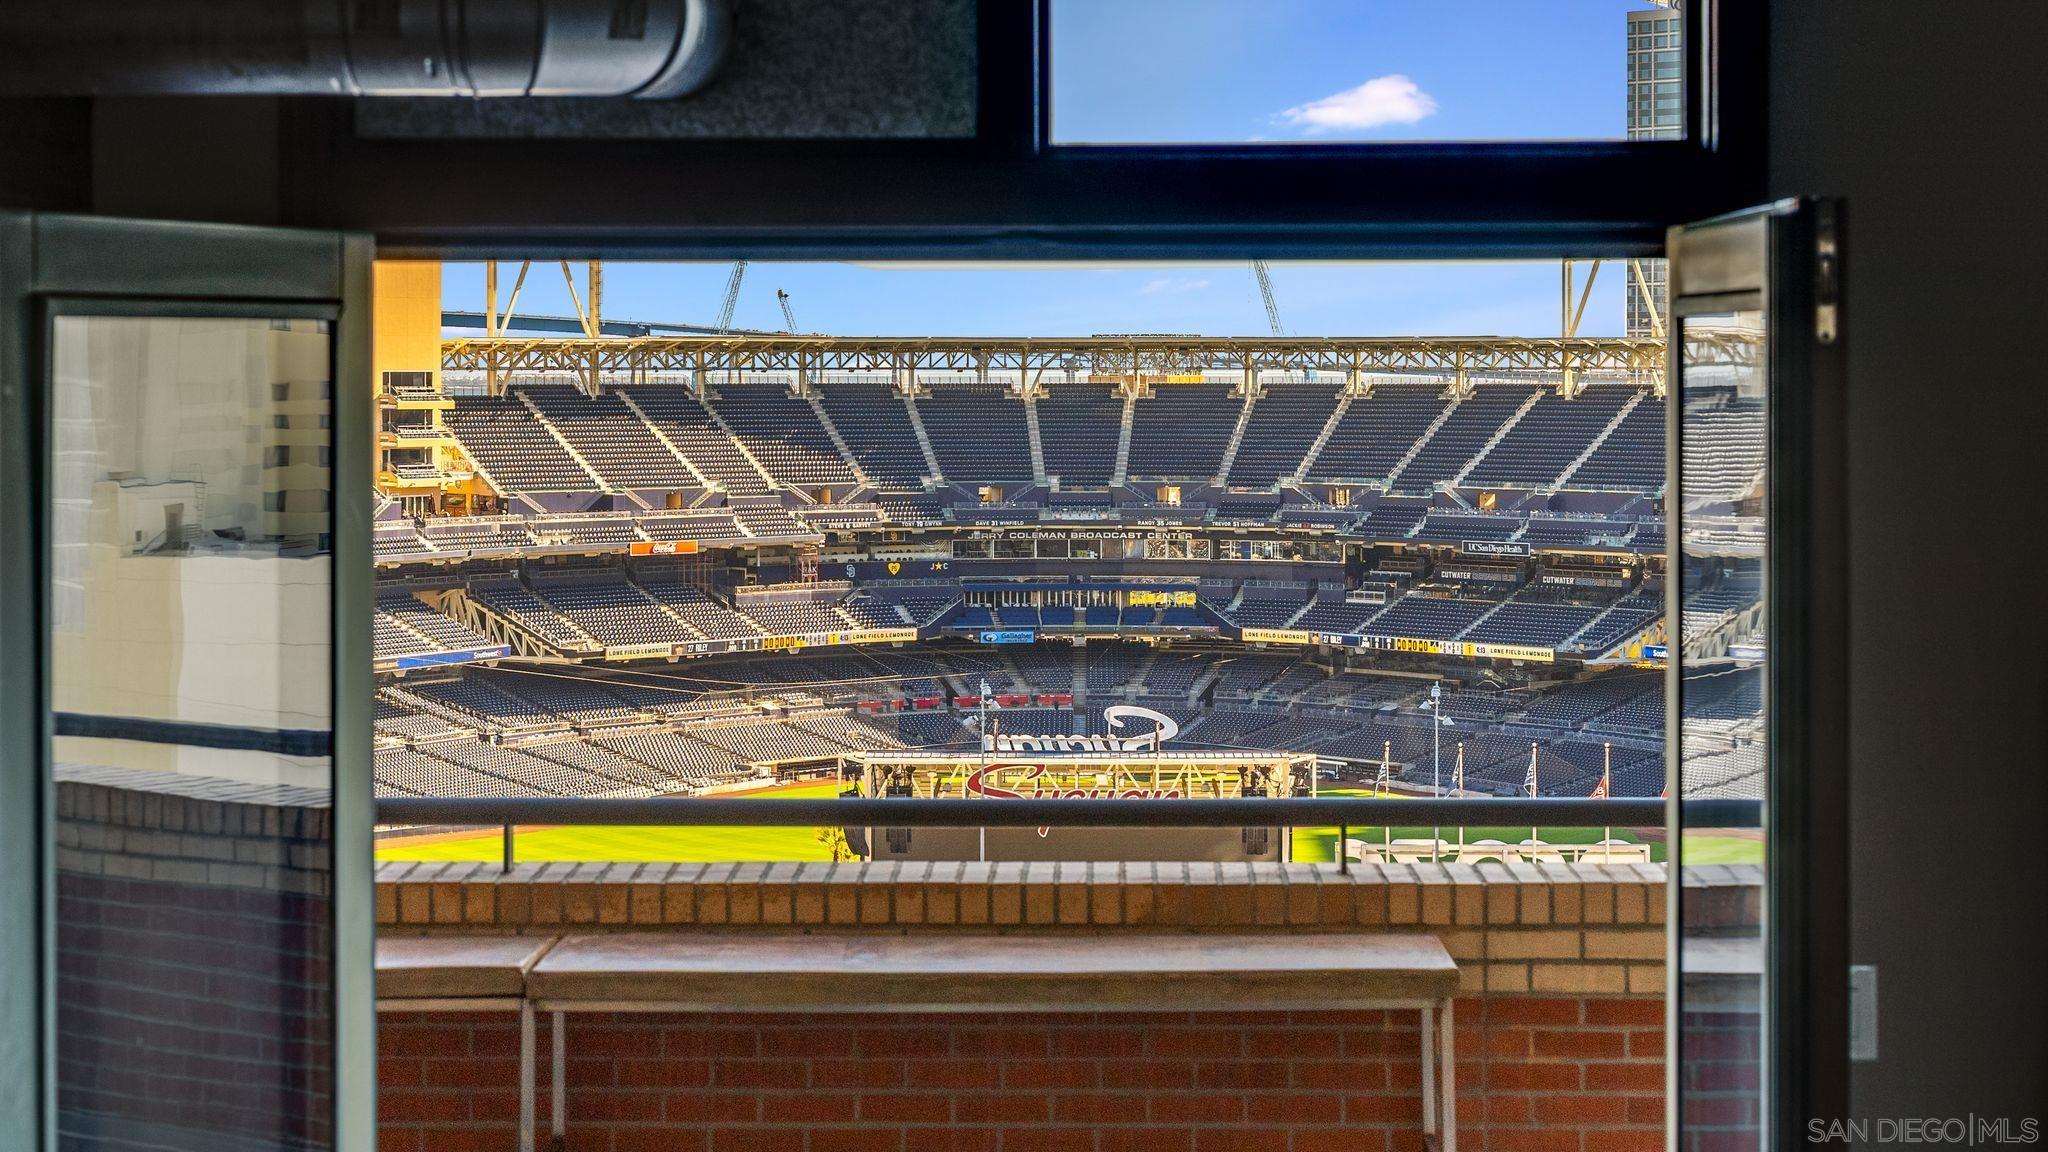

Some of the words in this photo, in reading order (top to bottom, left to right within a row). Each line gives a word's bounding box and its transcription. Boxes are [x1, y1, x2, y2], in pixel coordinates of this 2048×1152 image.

[968, 532, 1004, 540] JERRY
[1147, 532, 1193, 540] CENTER
[1468, 543, 1478, 552] UC
[1478, 544, 1488, 552] San
[1504, 545, 1522, 554] Health
[1441, 570, 1471, 580] CUTWATER
[1542, 576, 1574, 585] CUTWATER
